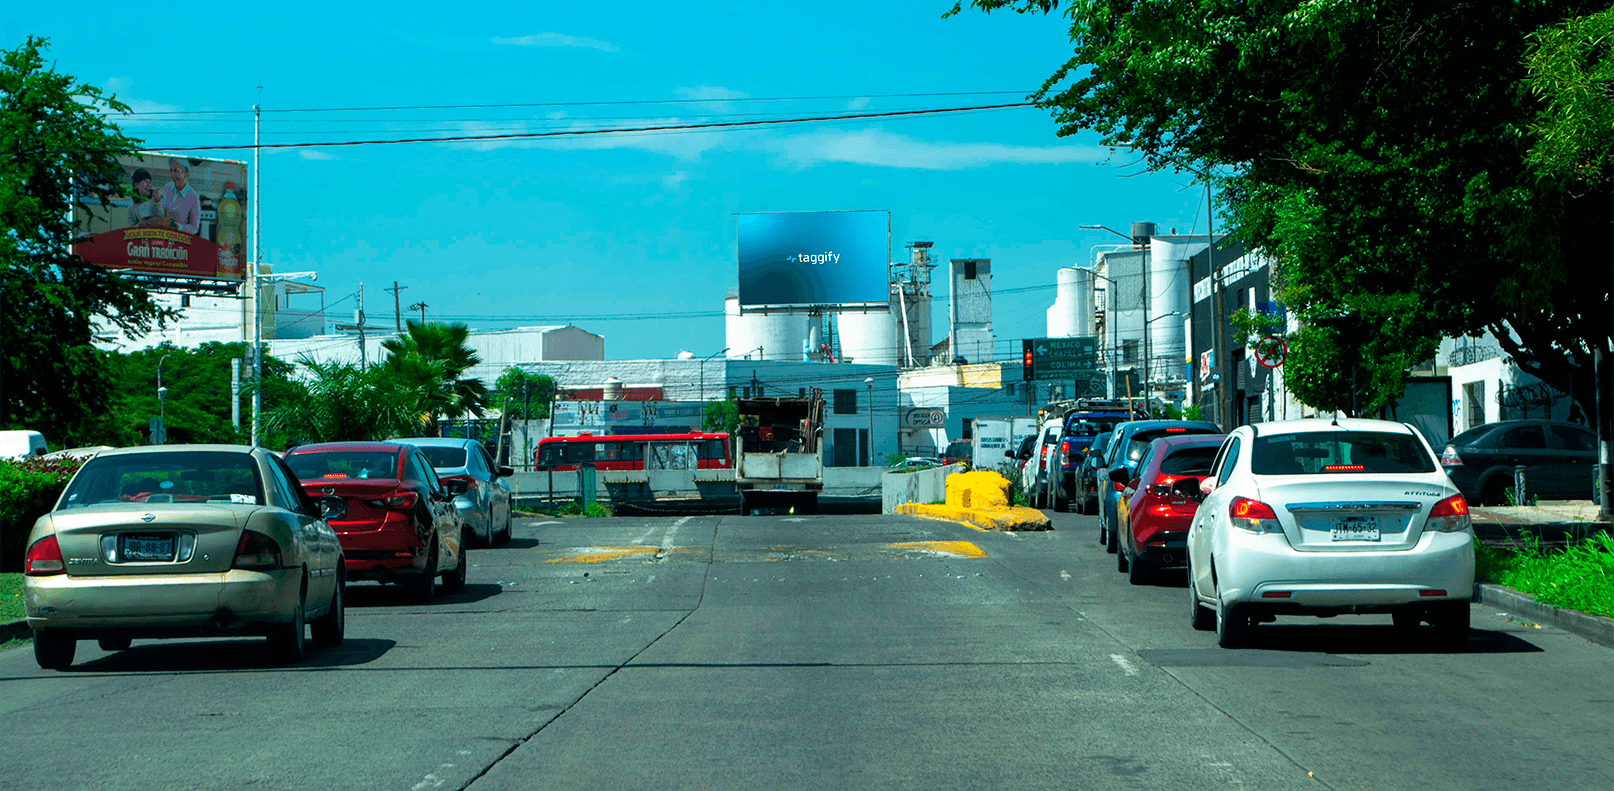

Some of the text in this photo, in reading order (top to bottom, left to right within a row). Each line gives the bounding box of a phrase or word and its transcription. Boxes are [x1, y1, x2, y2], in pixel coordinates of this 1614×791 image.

[798, 251, 840, 265] taggify
[1050, 341, 1081, 349] MEXICO
[1334, 522, 1377, 533] JTM-65-32
[68, 557, 99, 566] SENTRA
